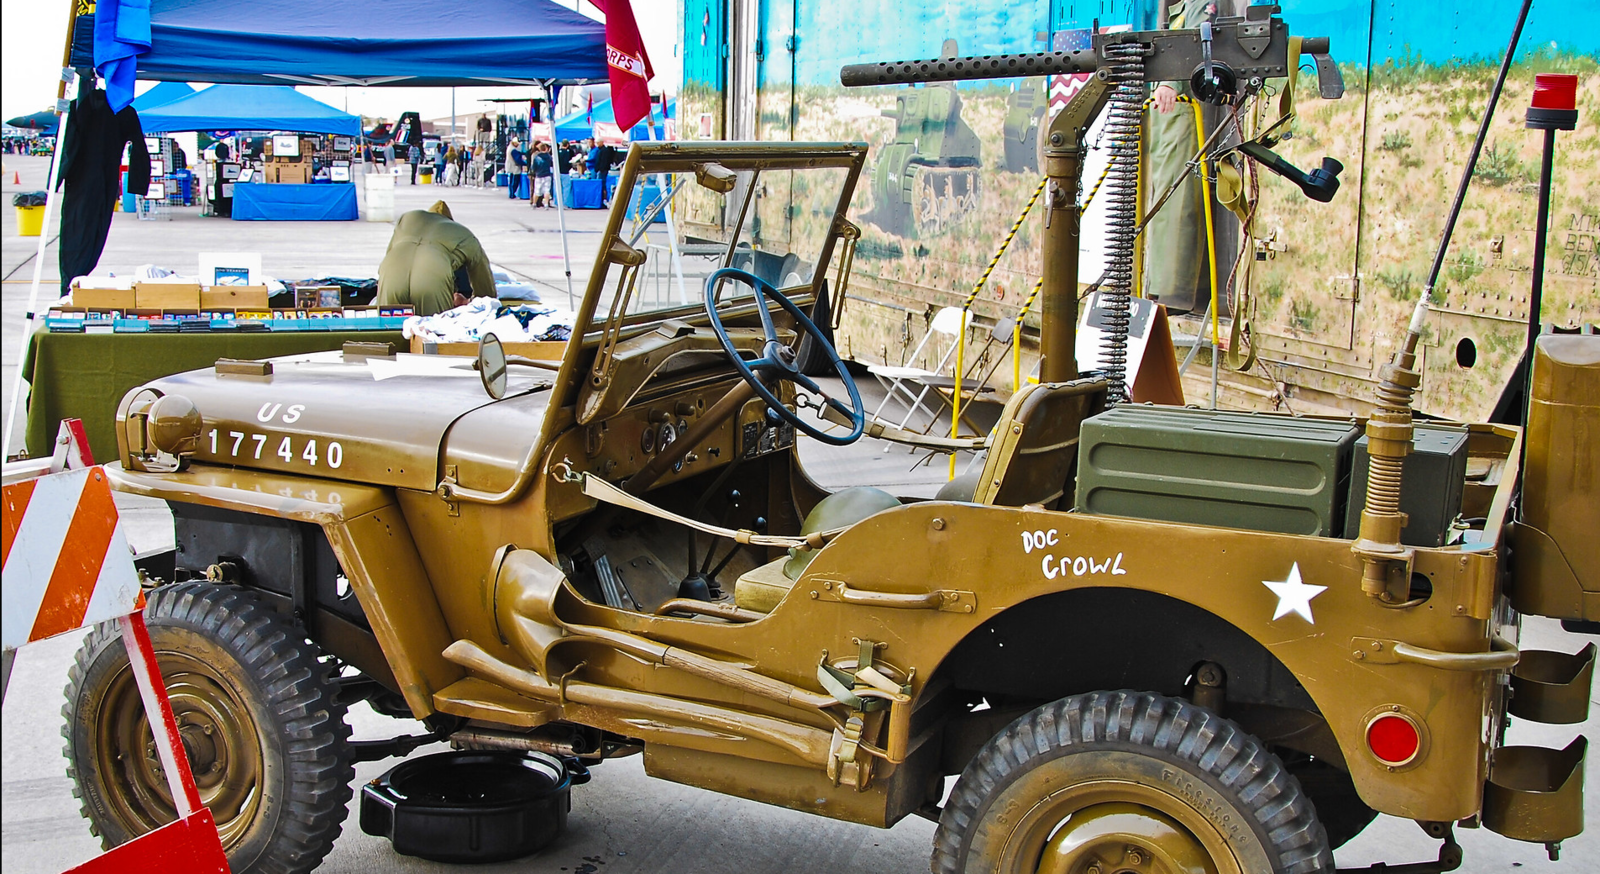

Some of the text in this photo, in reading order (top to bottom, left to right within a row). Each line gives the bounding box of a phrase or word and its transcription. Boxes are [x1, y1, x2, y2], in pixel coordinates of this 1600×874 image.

[257, 402, 306, 424] US
[208, 428, 343, 469] 177440
[1021, 528, 1059, 554] DOC
